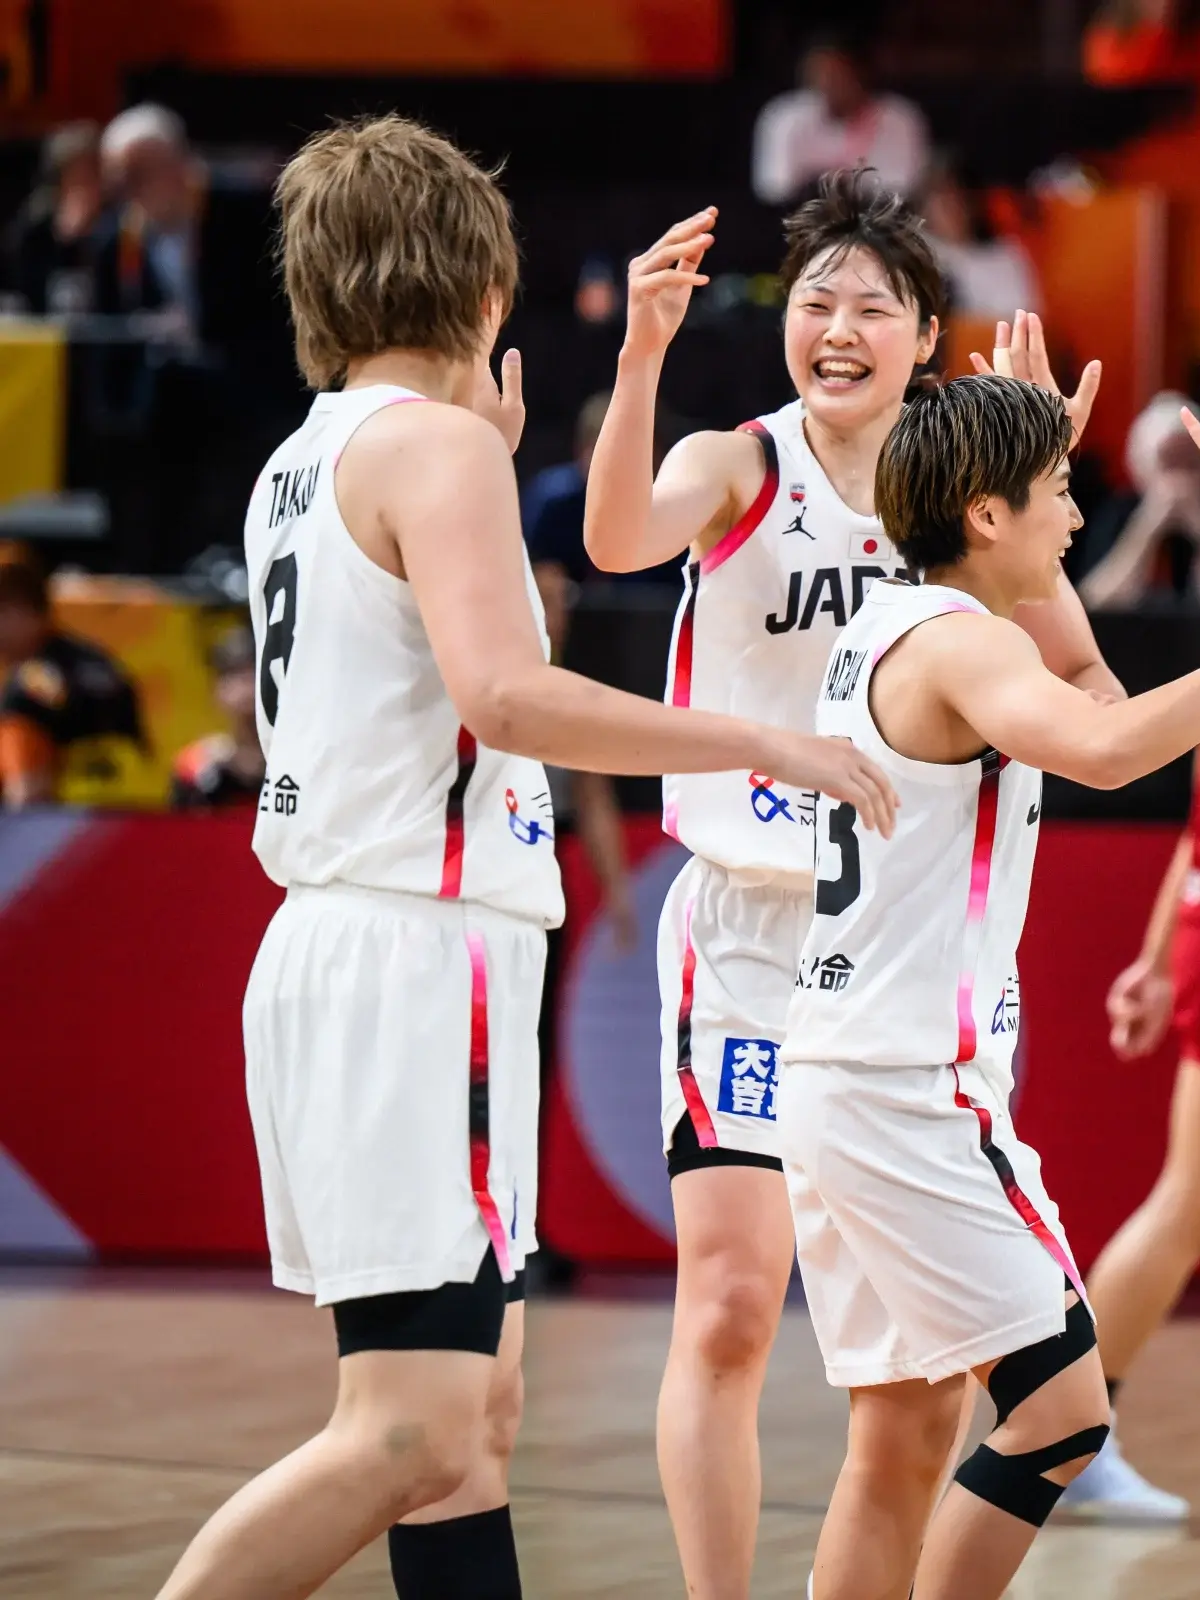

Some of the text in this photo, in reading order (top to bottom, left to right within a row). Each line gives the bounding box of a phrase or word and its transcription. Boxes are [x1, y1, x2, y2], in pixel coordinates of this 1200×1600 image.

[260, 550, 298, 727] 8
[765, 566, 920, 635] JAP
[815, 789, 861, 917] 3
